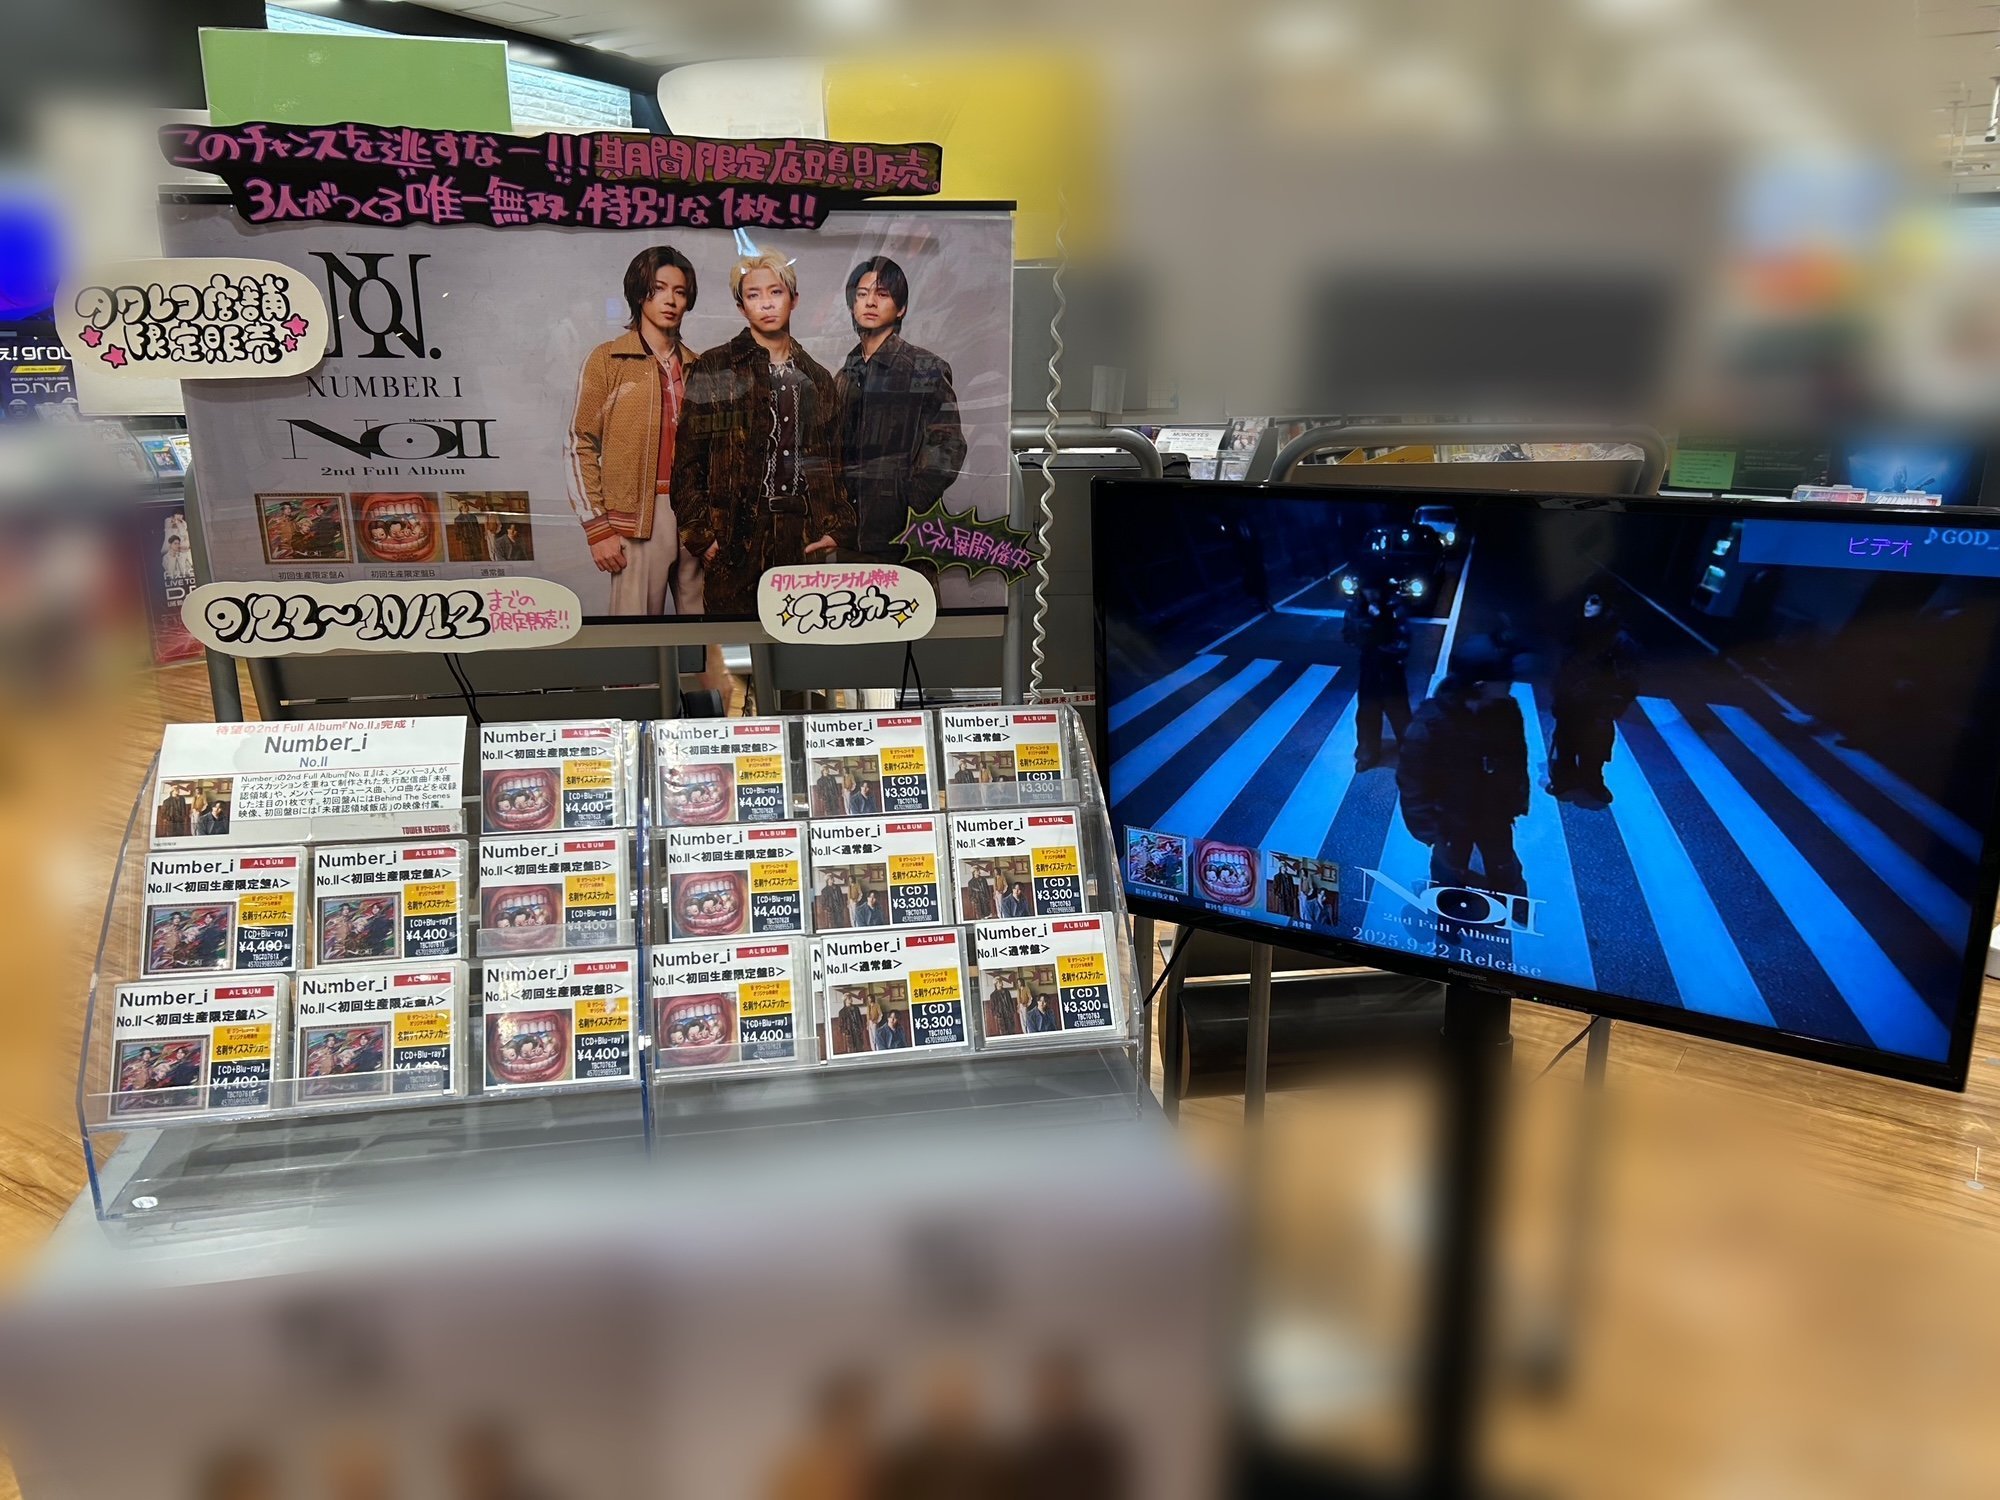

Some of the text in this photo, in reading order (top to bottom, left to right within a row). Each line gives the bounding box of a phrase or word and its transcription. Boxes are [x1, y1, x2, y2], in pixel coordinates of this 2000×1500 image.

[75, 273, 290, 329] タワレコ店舗
[123, 322, 285, 365] 限定販売
[321, 466, 465, 476] 2nd Full Album
[1849, 536, 1912, 558] ビデオ
[164, 579, 185, 588] LIVE
[487, 589, 536, 608] までの
[793, 585, 911, 634] ステッカー
[283, 723, 304, 733] Full
[806, 719, 872, 733] Number_i
[945, 715, 1009, 728] Number_i
[264, 733, 368, 754] Number_i
[484, 730, 556, 743] Number_i
[885, 787, 919, 798] ¥3,300
[1021, 783, 1054, 792] ¥3,300
[404, 794, 419, 802] The
[421, 792, 451, 801] Scenes
[739, 796, 776, 807] ¥4,400
[565, 802, 604, 813] ¥4,400
[956, 818, 1024, 832] Number_i
[670, 831, 743, 846] Number_i
[811, 825, 881, 840] Number_i
[415, 849, 445, 857] ALBUM
[482, 843, 558, 859] Number_i
[318, 851, 397, 868] Number_i
[151, 859, 234, 875] Number_i
[1037, 889, 1073, 901] ¥3,300
[893, 898, 929, 909] ¥3,300
[754, 906, 792, 917] ¥4,400
[406, 929, 448, 941] ¥4,400
[977, 924, 1048, 941] Number_i
[1383, 912, 1511, 945] 2nd Full Album
[239, 941, 283, 953] ¥4,400
[827, 938, 901, 957] Number_i
[1352, 927, 1543, 978] 2025.9.22 Release
[653, 949, 731, 967] Number_i
[303, 977, 387, 995] Number_i
[120, 989, 208, 1007] Number_i
[1064, 1000, 1101, 1013] ¥3,300
[915, 1017, 954, 1029] ¥3,300
[743, 1030, 784, 1042] ¥4,400
[577, 1048, 620, 1061] ¥4,400
[212, 1076, 259, 1090] ¥4,400
